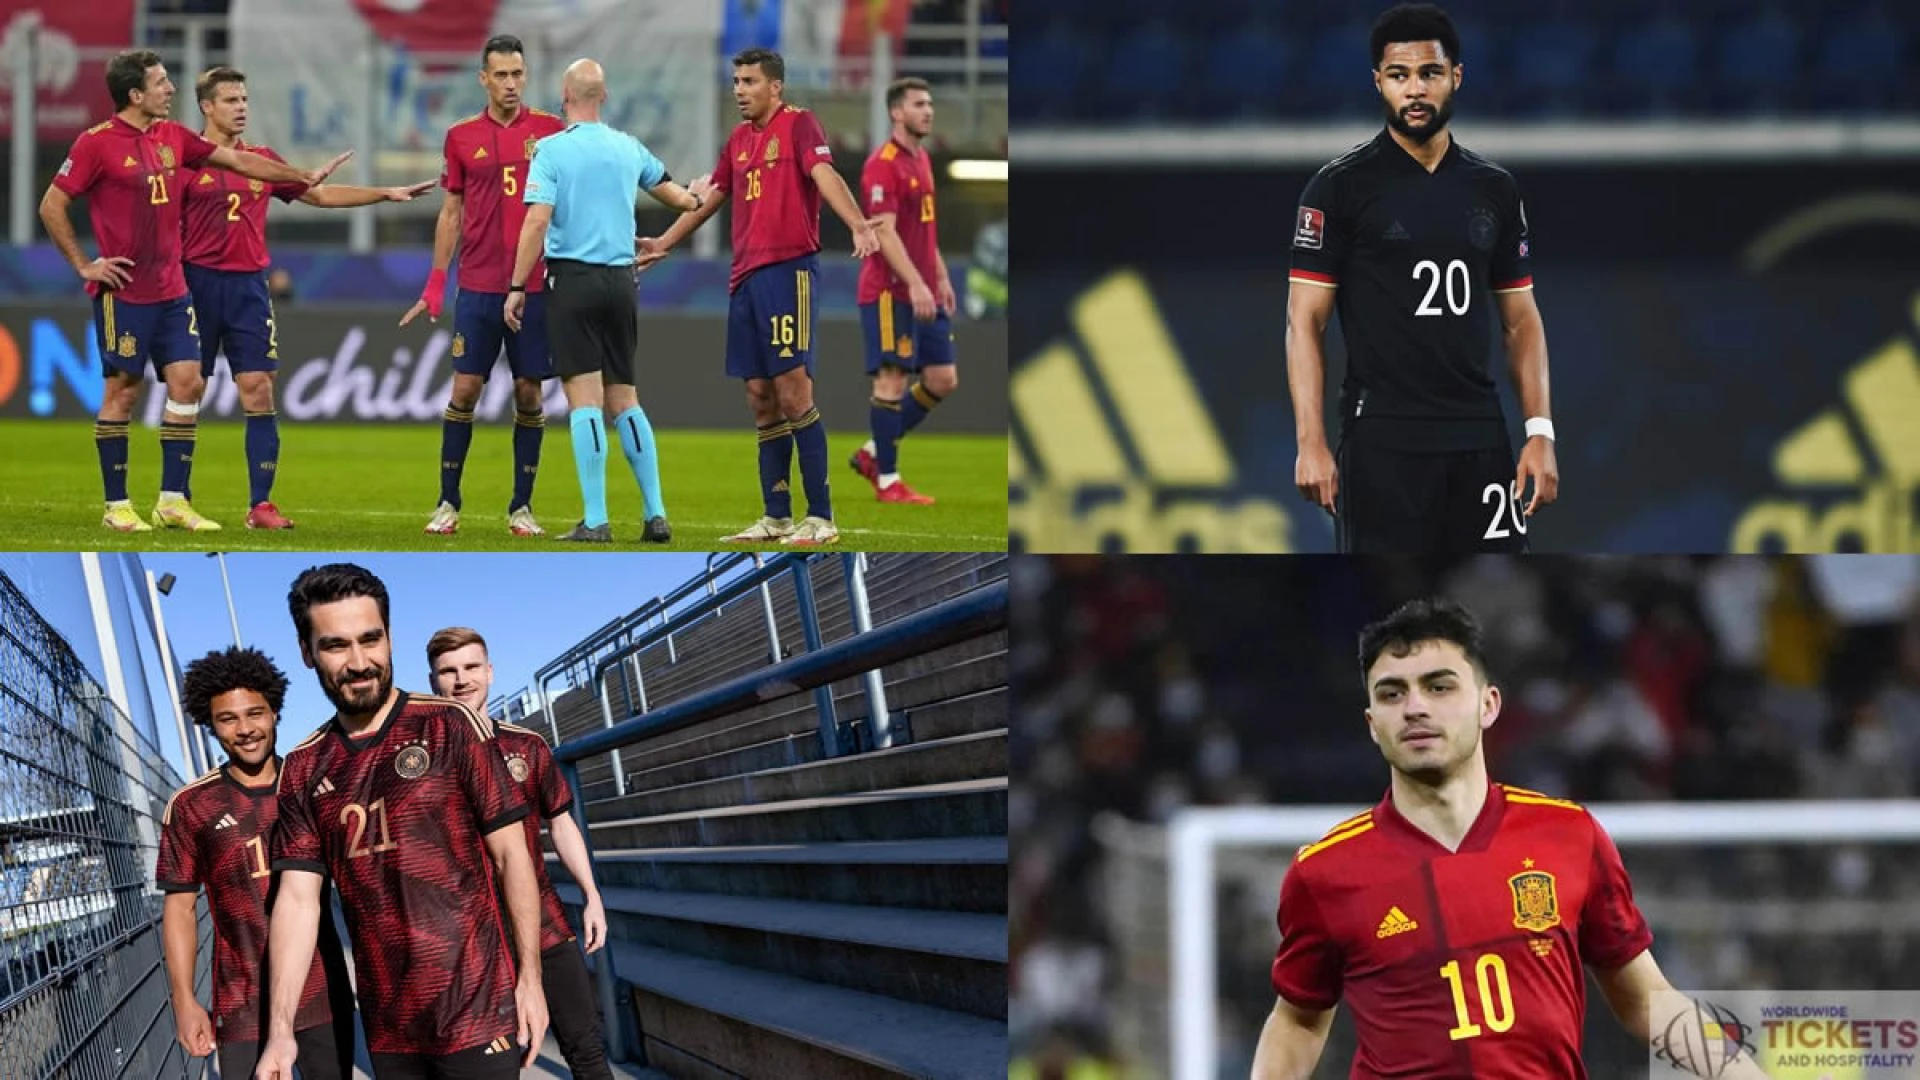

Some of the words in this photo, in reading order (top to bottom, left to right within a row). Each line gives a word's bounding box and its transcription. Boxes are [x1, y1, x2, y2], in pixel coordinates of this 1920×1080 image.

[147, 173, 169, 205] 21
[503, 166, 518, 196] 5
[745, 168, 761, 201] 16
[227, 193, 241, 221] 2
[1412, 259, 1471, 316] 20
[770, 314, 794, 345] 16
[340, 797, 398, 858] 21
[1376, 919, 1418, 939] adidas
[1440, 953, 1516, 1041] 10
